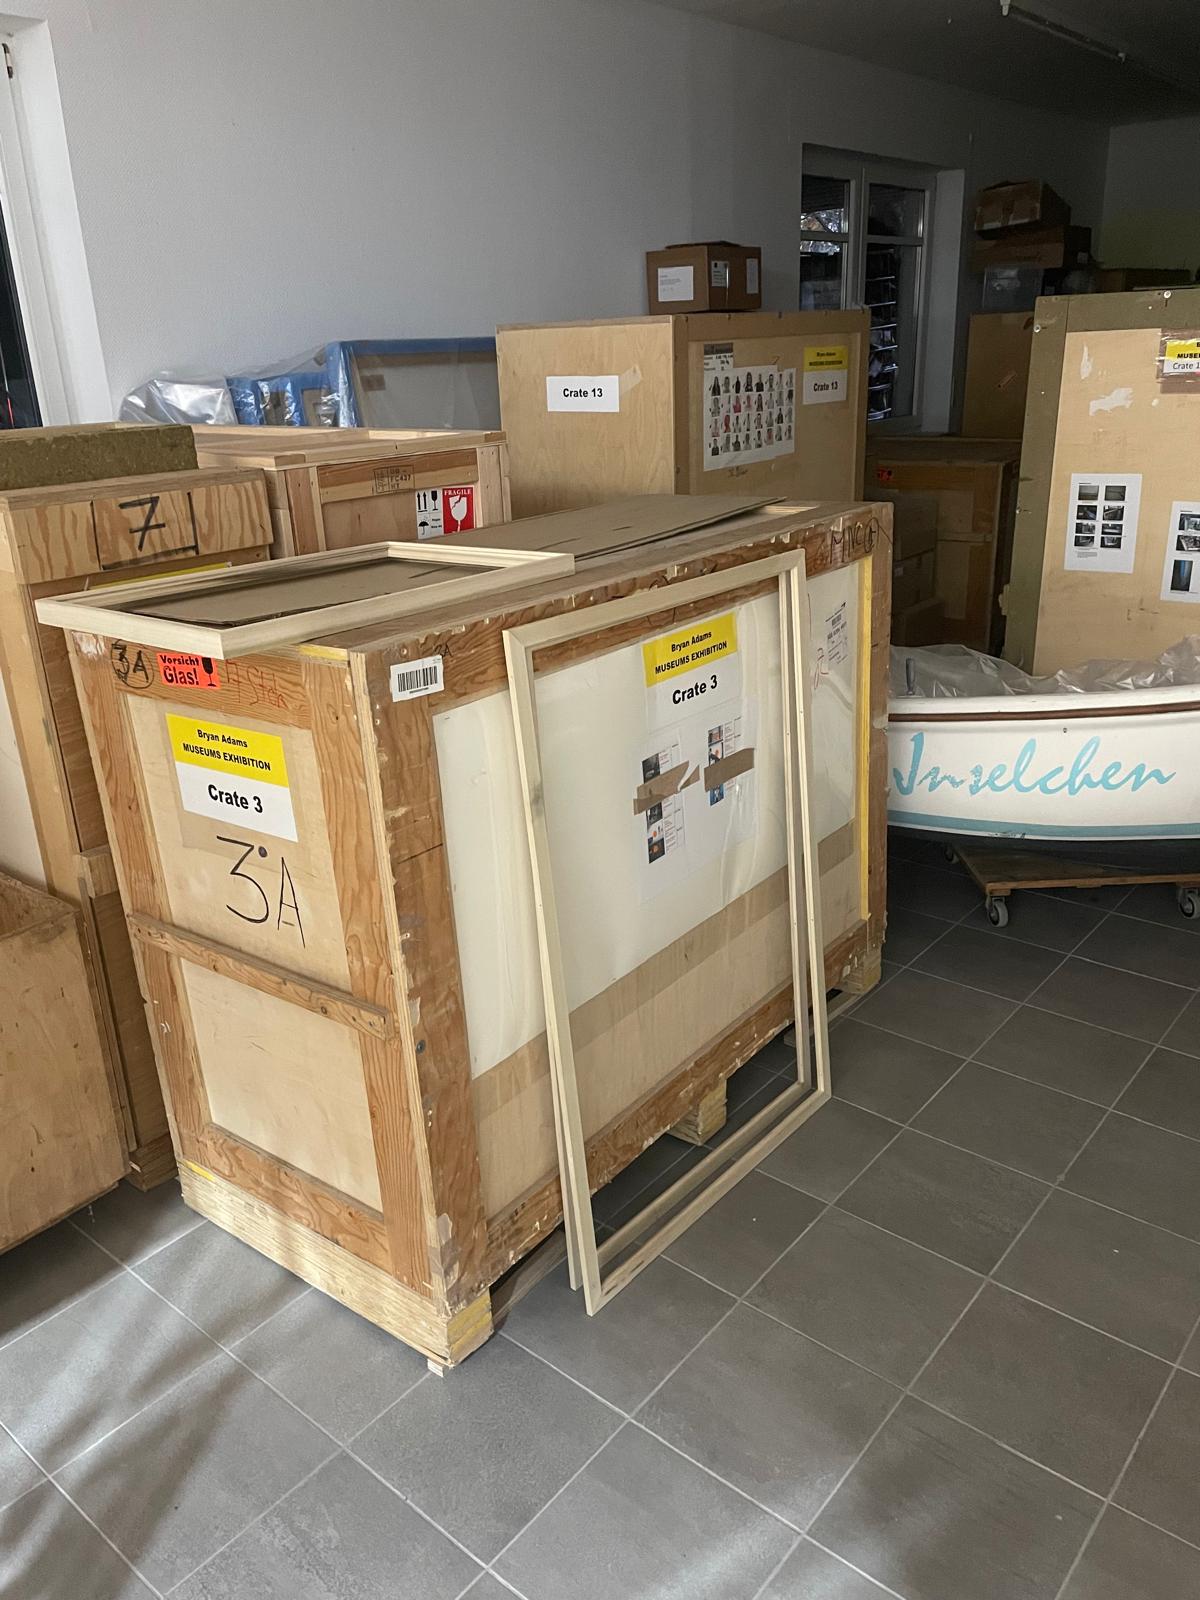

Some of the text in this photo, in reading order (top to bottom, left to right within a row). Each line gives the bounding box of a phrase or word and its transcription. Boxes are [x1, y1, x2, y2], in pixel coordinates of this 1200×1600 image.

[1172, 362, 1194, 370] Crate
[563, 387, 603, 398] Crate 13
[813, 380, 838, 392] Crate 13
[444, 488, 472, 496] FRAGILE
[118, 496, 166, 552] 7
[671, 631, 712, 652] Bryan Adams
[159, 654, 200, 666] Vorsicht
[655, 640, 728, 675] MUSEUMS EXHIBITION
[163, 665, 200, 686] Glas!
[672, 674, 718, 705] Crate 3
[197, 729, 248, 748] Bryan Adams
[183, 743, 271, 771] MUSEUMS EXHIBITION
[207, 784, 264, 814] Crate 3
